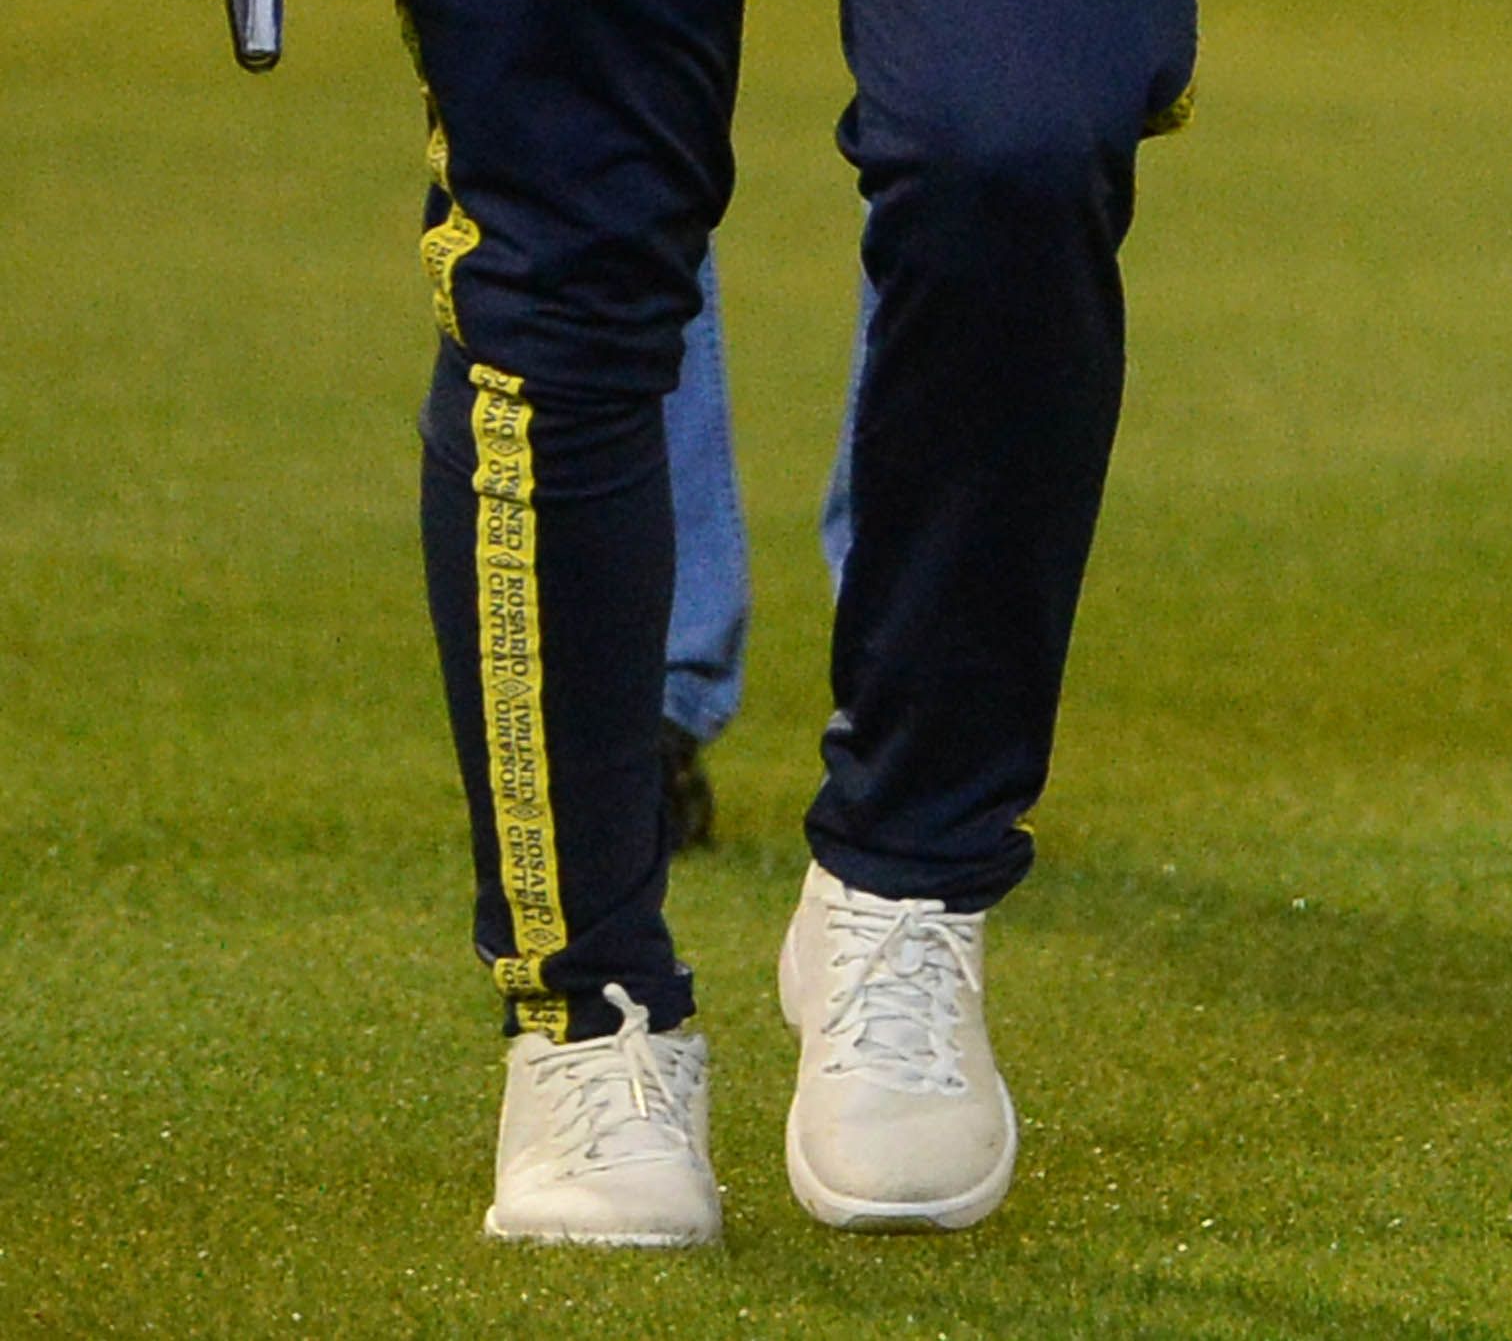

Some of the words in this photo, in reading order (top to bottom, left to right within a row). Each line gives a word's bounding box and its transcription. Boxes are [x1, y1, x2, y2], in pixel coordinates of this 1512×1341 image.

[488, 573, 508, 676] CENTRAL
[507, 577, 529, 676] ROSARIO
[507, 825, 536, 923] CENTRAL
[526, 828, 554, 925] ROSARIO
